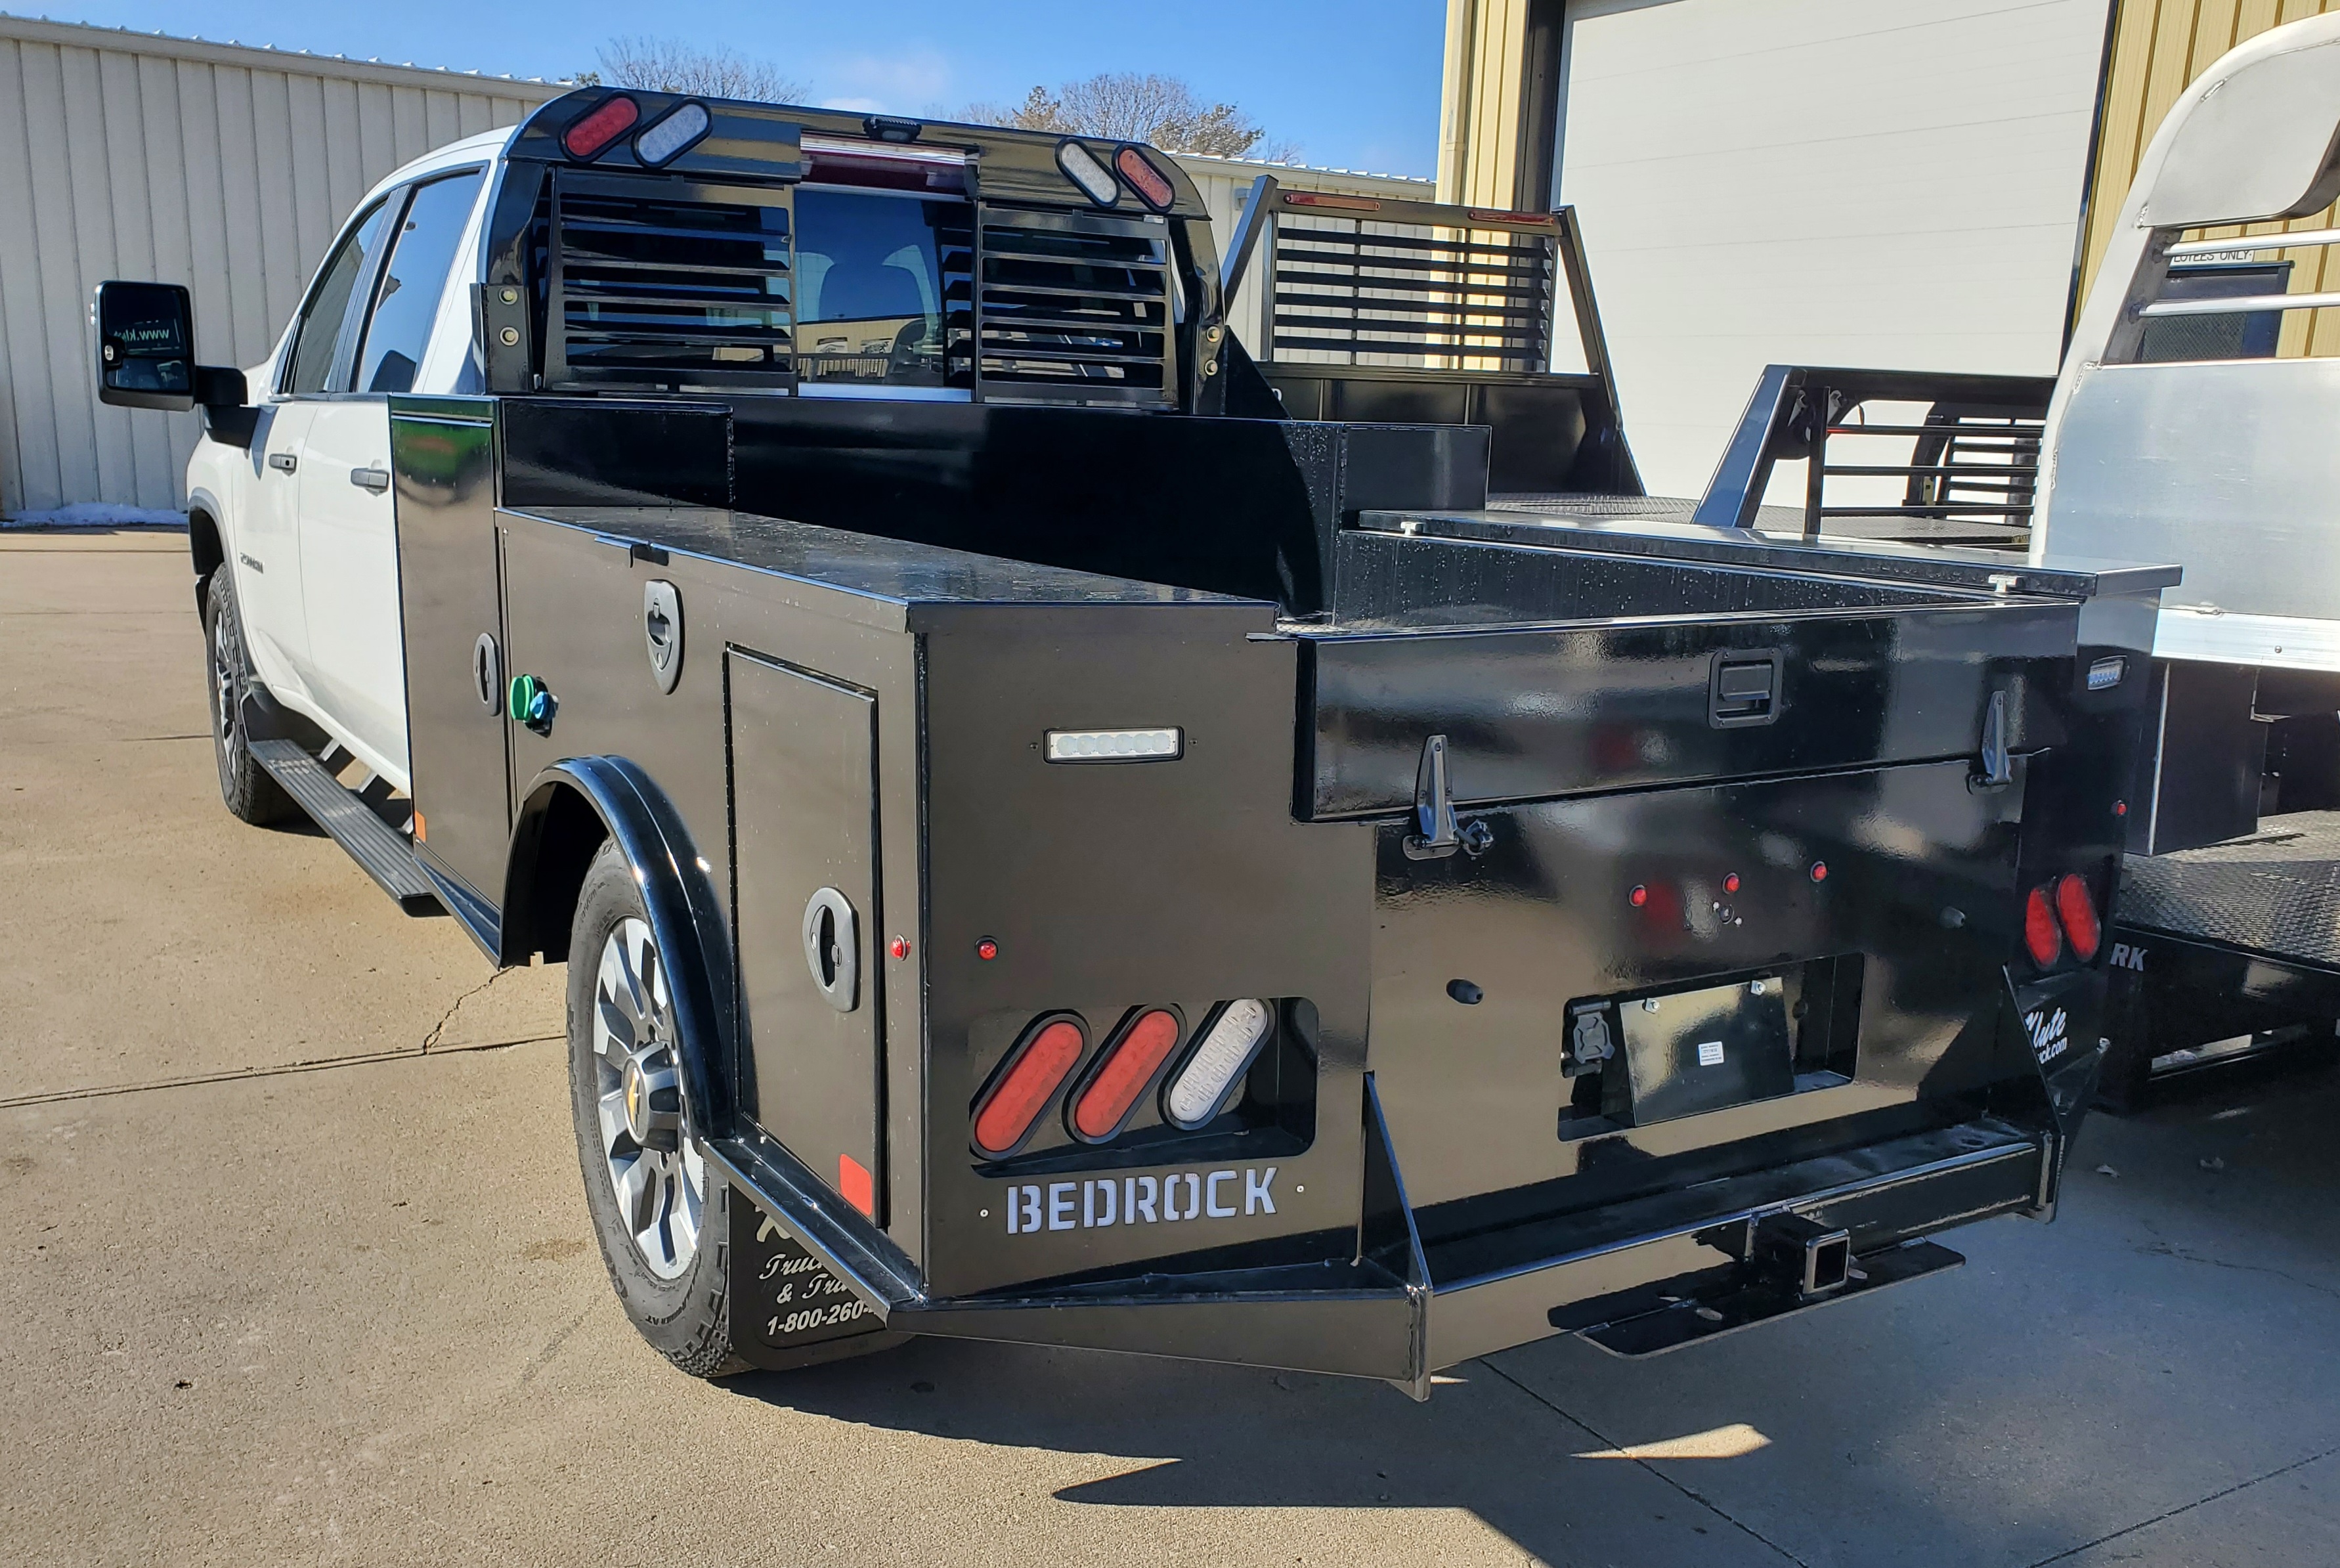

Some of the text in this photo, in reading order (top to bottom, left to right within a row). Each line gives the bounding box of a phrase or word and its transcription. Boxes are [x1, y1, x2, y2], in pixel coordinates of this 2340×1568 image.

[2220, 250, 2249, 261] ONLY
[1007, 1166, 1278, 1235] BEDROCK
[776, 1283, 793, 1304] &
[767, 1299, 875, 1336] 1-800-260-
